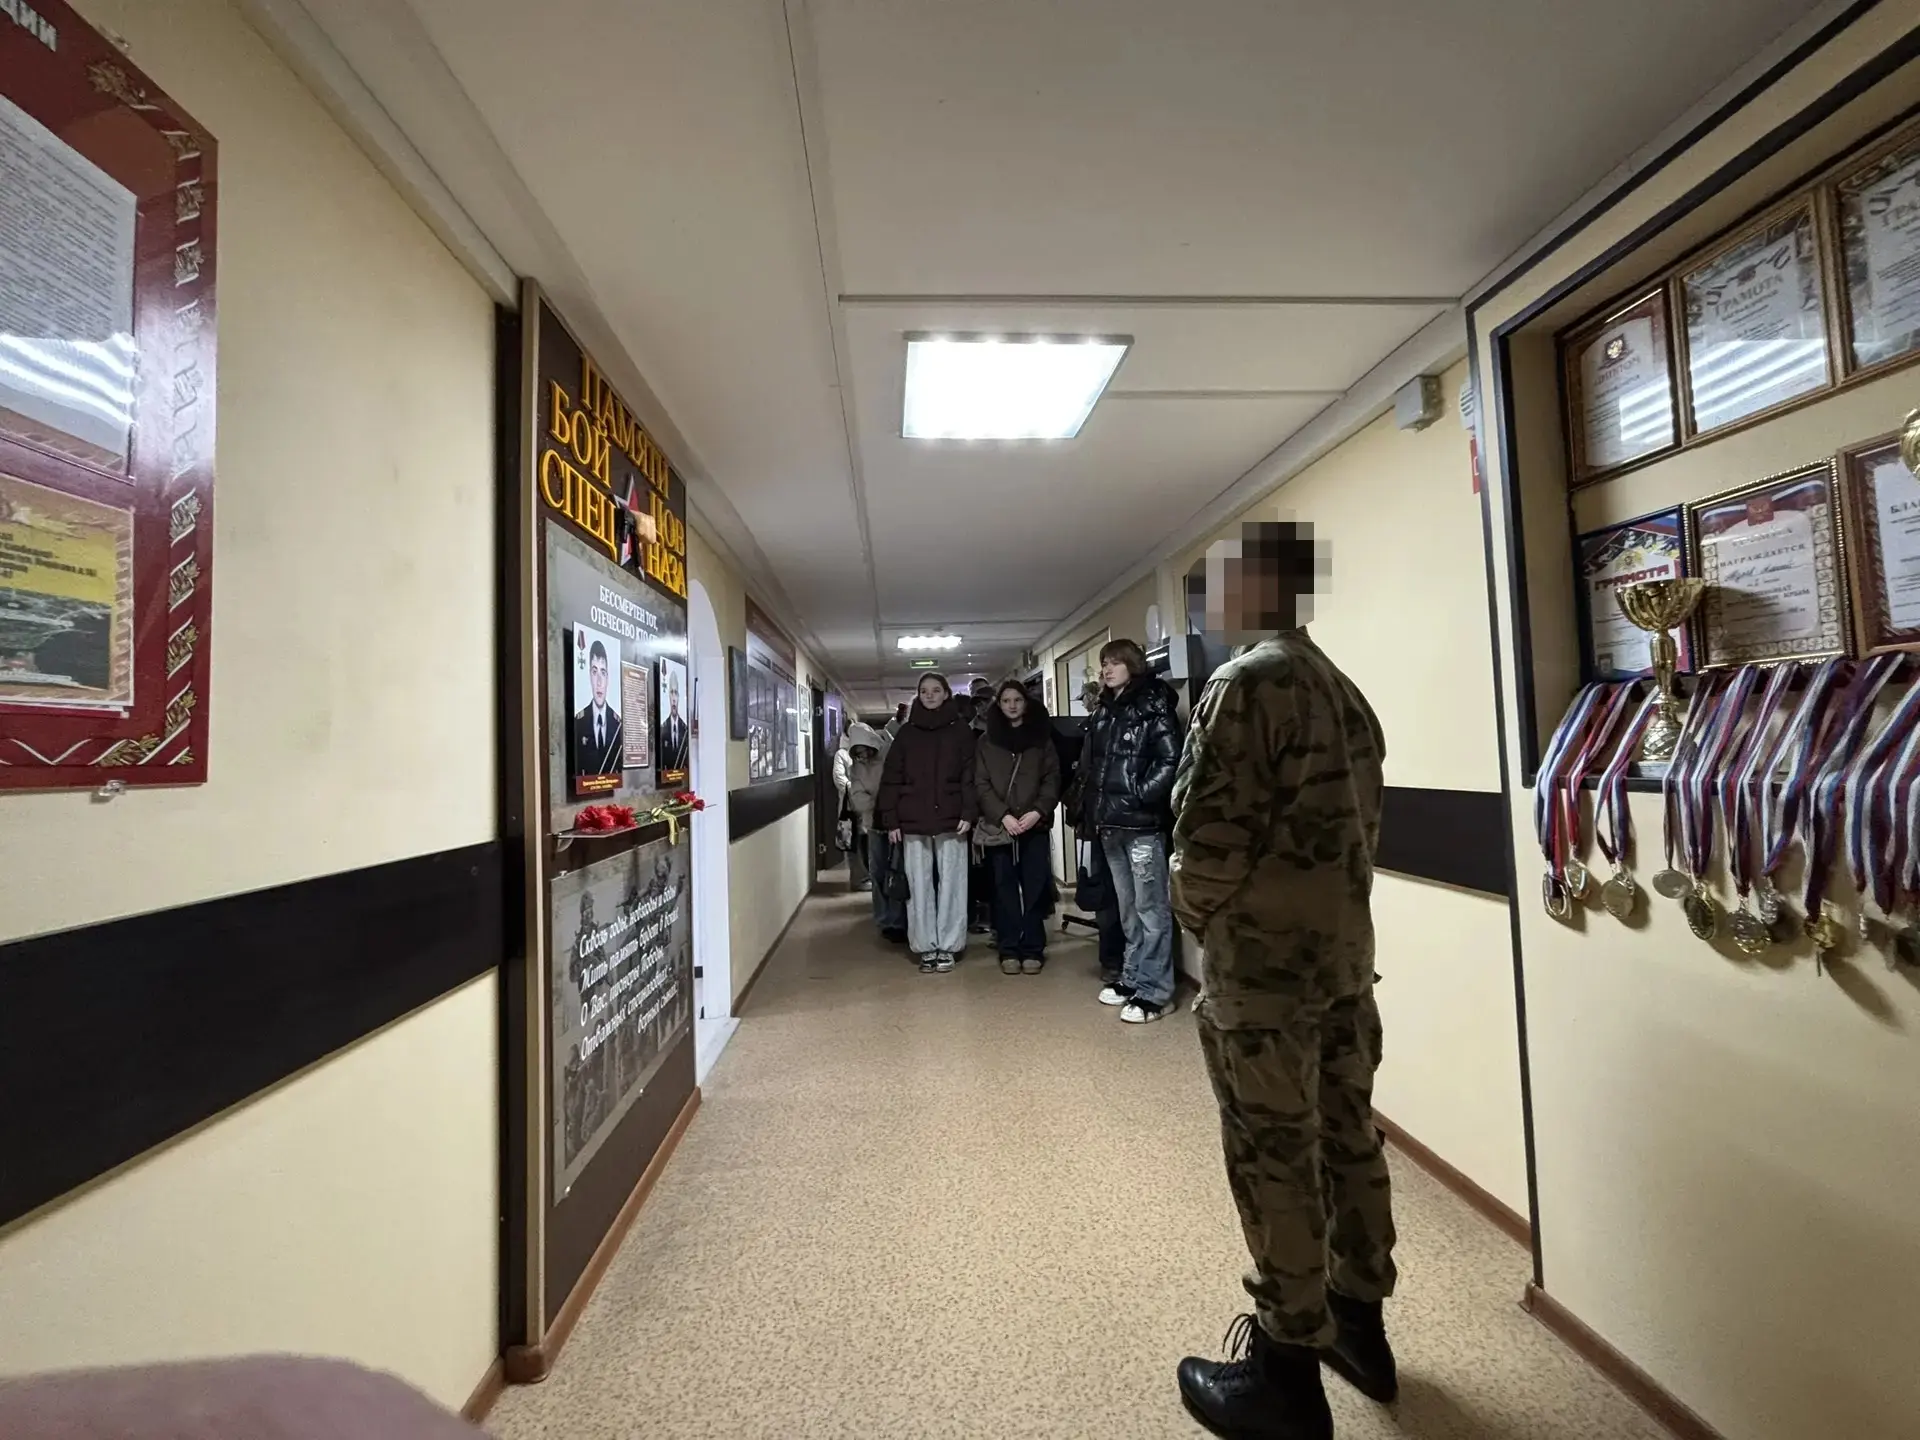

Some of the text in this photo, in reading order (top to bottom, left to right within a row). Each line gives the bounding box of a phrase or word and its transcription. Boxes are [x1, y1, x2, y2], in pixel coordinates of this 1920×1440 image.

[581, 354, 670, 500] ПАМЯТИ
[539, 448, 618, 563] СПЕЦ
[1595, 564, 1670, 591] ГРАМОТА
[591, 605, 636, 639] ОТЕЧЕСТВО
[600, 585, 660, 632] БЕССМЕРТЕН ТОТ,
[581, 1002, 588, 1028] О
